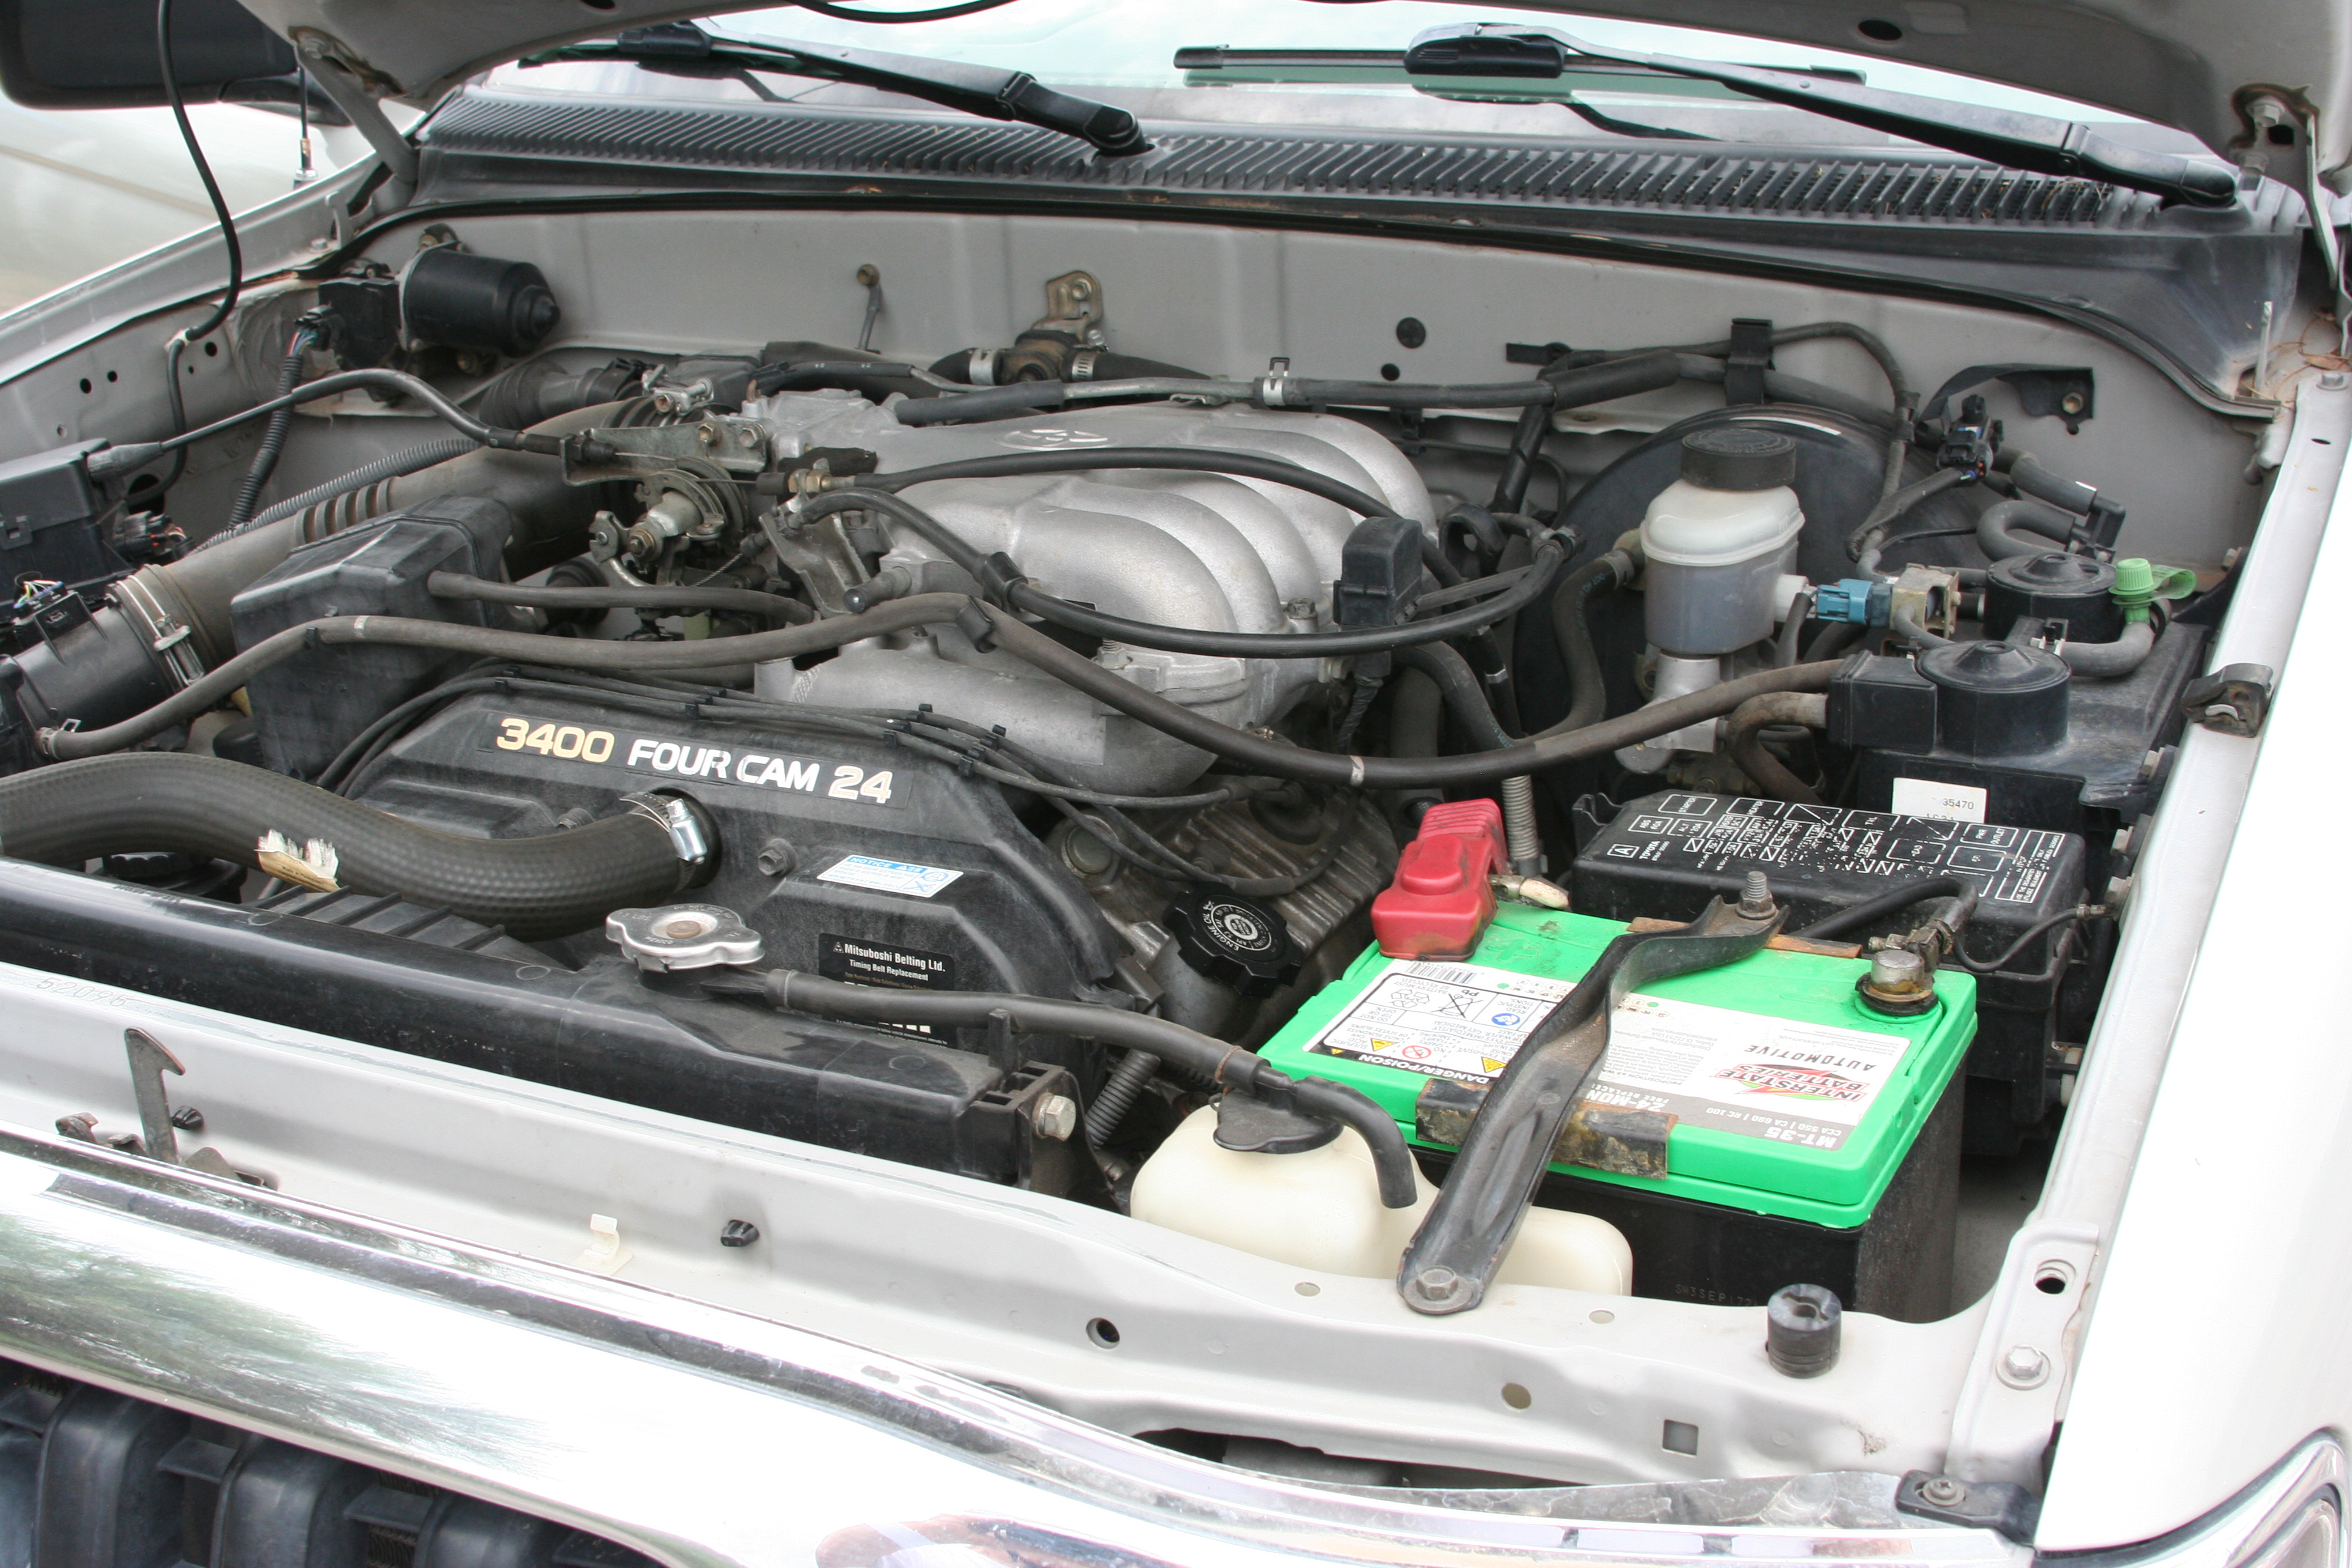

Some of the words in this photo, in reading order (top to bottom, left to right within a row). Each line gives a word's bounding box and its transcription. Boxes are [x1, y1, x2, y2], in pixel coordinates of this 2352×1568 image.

[495, 717, 615, 763] 3400
[627, 738, 732, 778] FOUR
[736, 754, 821, 791] CAM
[828, 764, 894, 803] 24
[1942, 798, 1974, 810] 35470
[1638, 840, 1661, 860] TOYOTA
[850, 858, 891, 868] NOTICE
[1203, 913, 1212, 924] OIL
[644, 936, 674, 945] MEXICO
[1207, 925, 1239, 951] ENGINE
[845, 943, 892, 962] Mitsuboshi
[894, 953, 926, 970] Belting
[928, 959, 946, 972] Ltd.
[849, 959, 871, 971] Timing
[872, 963, 885, 973] Belt
[886, 966, 928, 981] Replacement
[1744, 1045, 1876, 1072] AUTOMOTIVE
[1358, 1054, 1490, 1085] DANGER/POISON
[1628, 1074, 1682, 1085] PROPOSITION
[1738, 1064, 1863, 1090] BATTERIES
[1717, 1069, 1861, 1100] INTERSTATE
[1643, 1094, 1669, 1104] FREE
[1705, 1107, 1728, 1117] 100
[1727, 1110, 1743, 1120] RC
[1750, 1114, 1774, 1125] 690
[1774, 1117, 1790, 1128] CA
[1797, 1122, 1820, 1132] 550
[1819, 1126, 1842, 1137] CCA
[1765, 1126, 1838, 1148] MT-35
